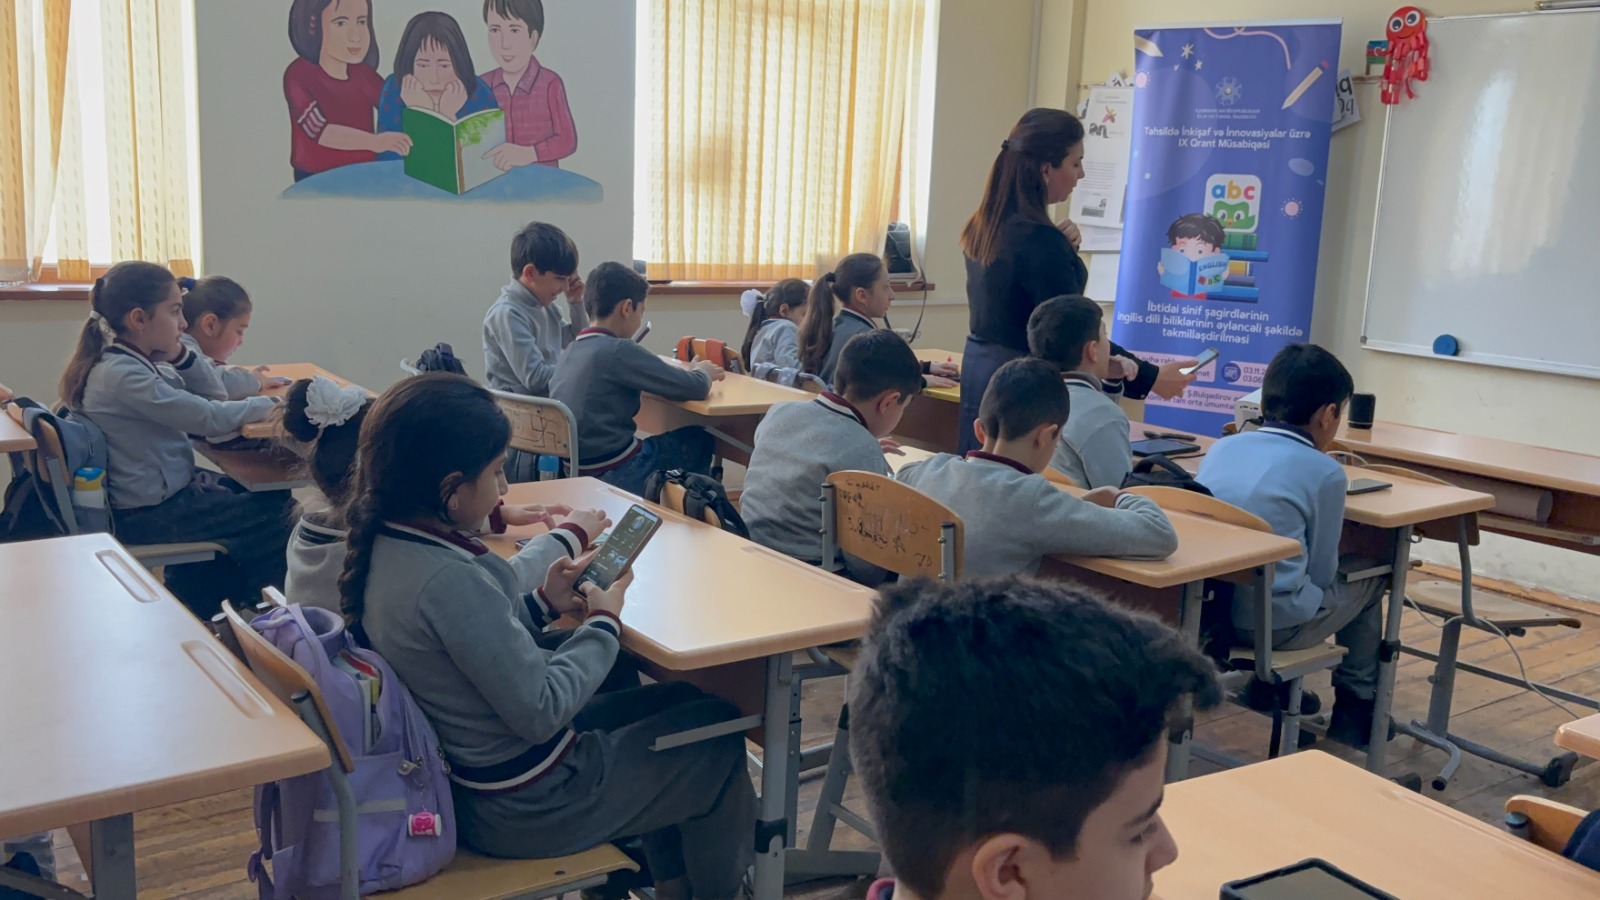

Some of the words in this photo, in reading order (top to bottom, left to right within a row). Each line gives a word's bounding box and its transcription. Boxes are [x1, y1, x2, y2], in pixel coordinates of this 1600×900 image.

[1181, 125, 1212, 138] İnkişaf
[1213, 129, 1225, 137] və
[1226, 125, 1287, 140] İnnovasiyalar
[1289, 128, 1311, 139] üzrə
[1178, 138, 1188, 147] IX
[1218, 138, 1270, 152] Müsabiqəsi
[1211, 180, 1256, 201] abc
[1147, 300, 1180, 313] İbtidai
[1181, 304, 1203, 315] sinif
[1204, 307, 1270, 322] şagirdlərinin
[1145, 313, 1160, 324] dili
[1162, 314, 1214, 329] biliklərinin
[1216, 320, 1262, 333] əyləncəli
[1264, 324, 1304, 337] şəkildə
[1243, 366, 1265, 376] 03.11.2
[1187, 399, 1203, 407] orta
